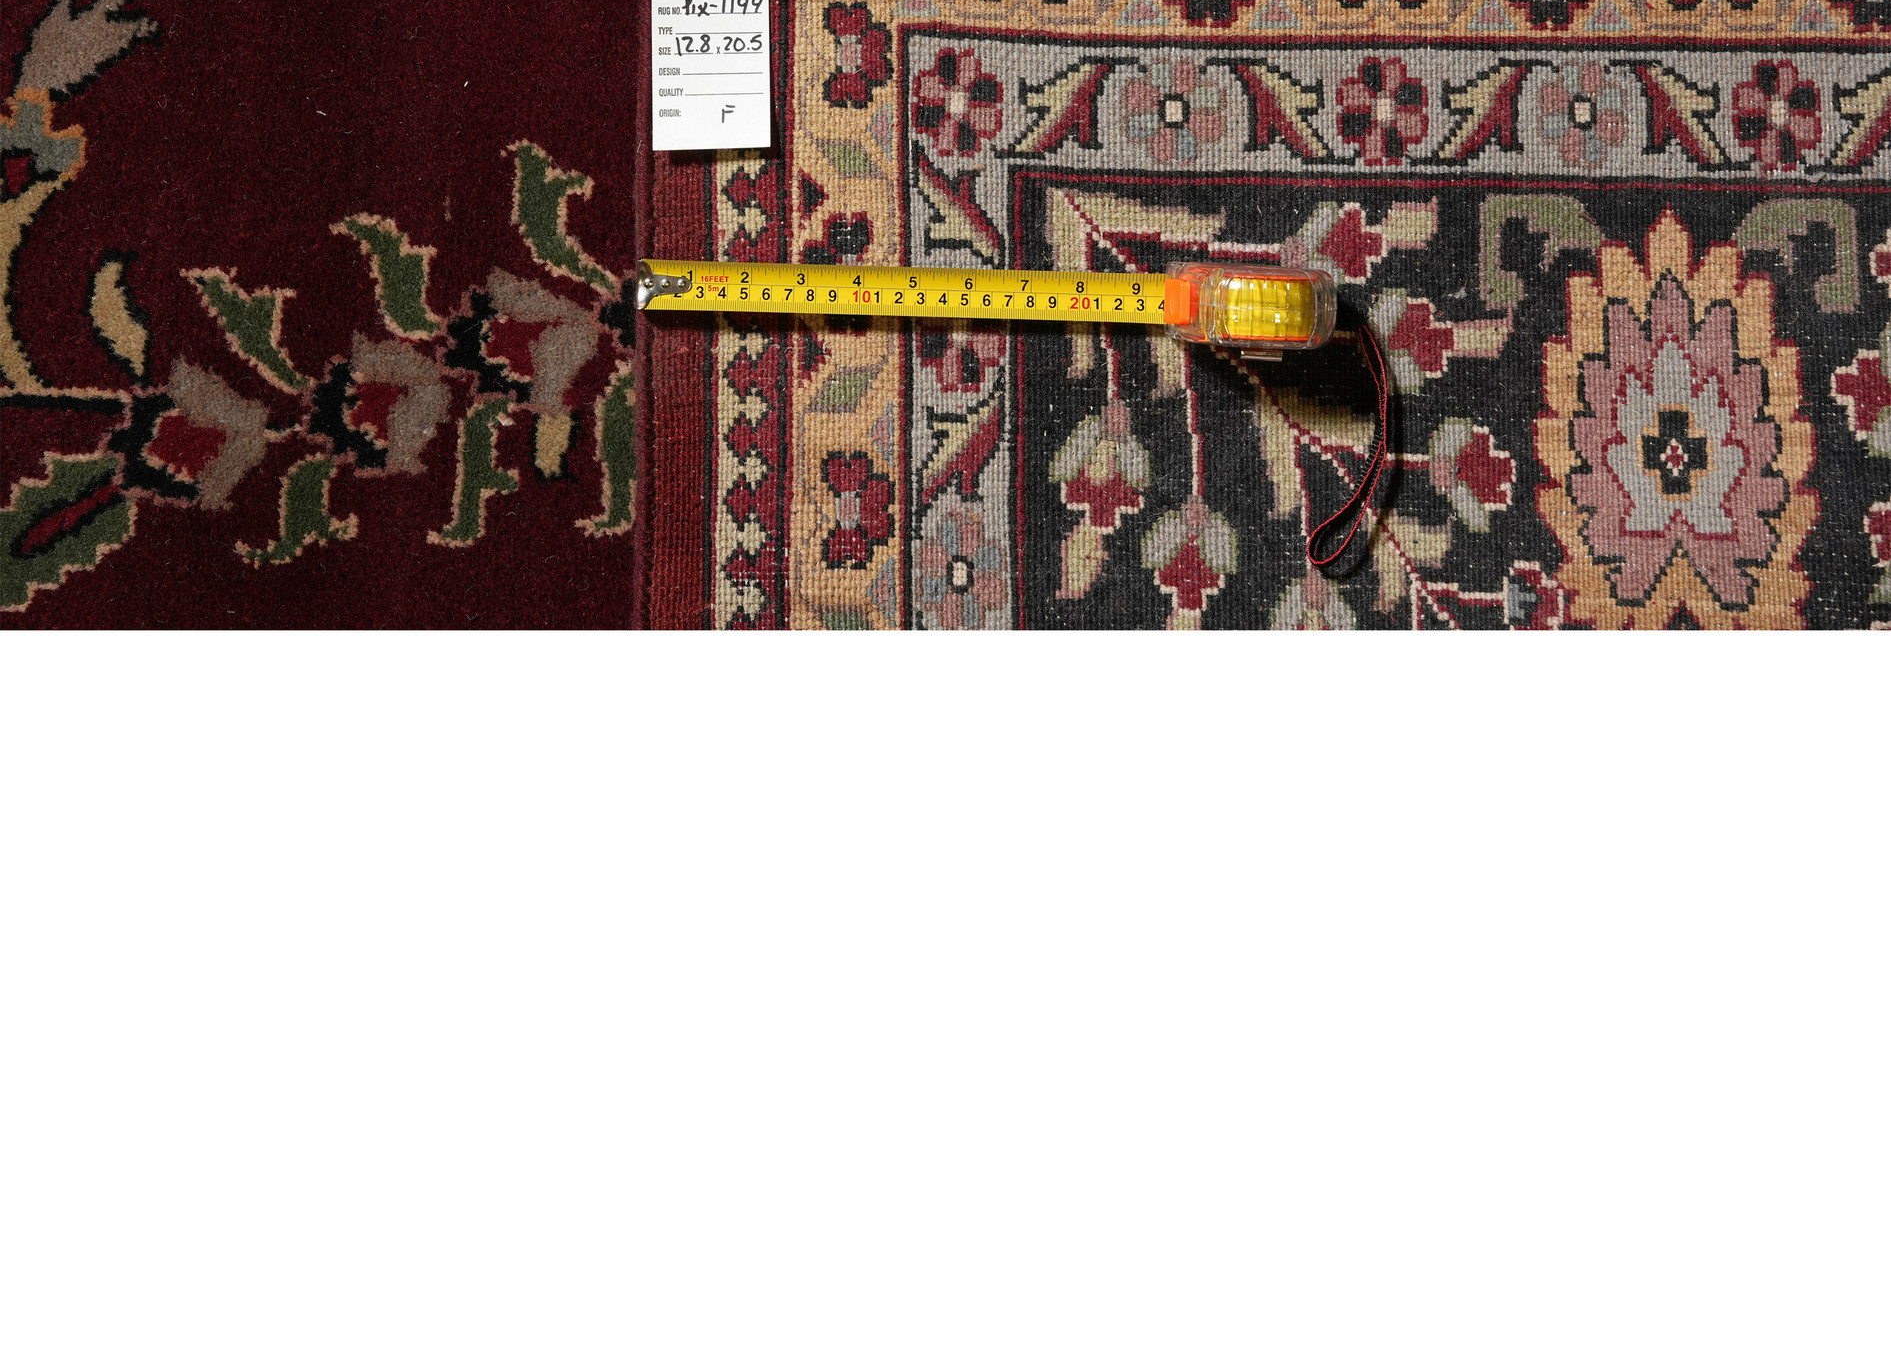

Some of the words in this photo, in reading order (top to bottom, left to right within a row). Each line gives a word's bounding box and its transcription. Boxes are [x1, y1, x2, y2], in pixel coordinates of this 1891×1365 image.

[657, 6, 671, 15] RUG
[671, 6, 682, 15] NO.
[658, 26, 673, 35] TYPE
[658, 47, 671, 55] SIZE
[675, 34, 711, 56] 12.8
[723, 34, 763, 52] 20.5
[658, 67, 681, 76] DESIGN
[658, 88, 684, 97] QUALITY
[658, 108, 682, 118] ORIGIN:
[687, 270, 693, 282] 1
[740, 271, 749, 283] 2
[796, 273, 806, 285] 3
[852, 274, 862, 287] 4
[908, 276, 917, 288] 5
[964, 278, 973, 290] 6
[1020, 279, 1029, 291] 7
[1075, 281, 1085, 293] 8
[1131, 282, 1141, 295] 9
[700, 275, 729, 283] 16FEET
[695, 286, 704, 299] 3
[717, 286, 727, 299] 4
[739, 287, 749, 300] 5
[762, 288, 771, 301] 6
[784, 288, 793, 301] 7
[806, 289, 815, 302] 8
[828, 289, 837, 302] 9
[852, 290, 871, 303] 10
[873, 291, 880, 304] 1
[894, 291, 903, 304] 2
[916, 292, 925, 305] 3
[938, 293, 947, 306] 4
[960, 293, 969, 306] 5
[982, 294, 991, 307] 6
[1004, 294, 1013, 307] 7
[1026, 295, 1035, 308] 8
[1048, 296, 1057, 309] 9
[1070, 296, 1091, 310] 20
[1093, 297, 1100, 310] 1
[1114, 298, 1123, 311] 2
[1136, 298, 1145, 311] 3
